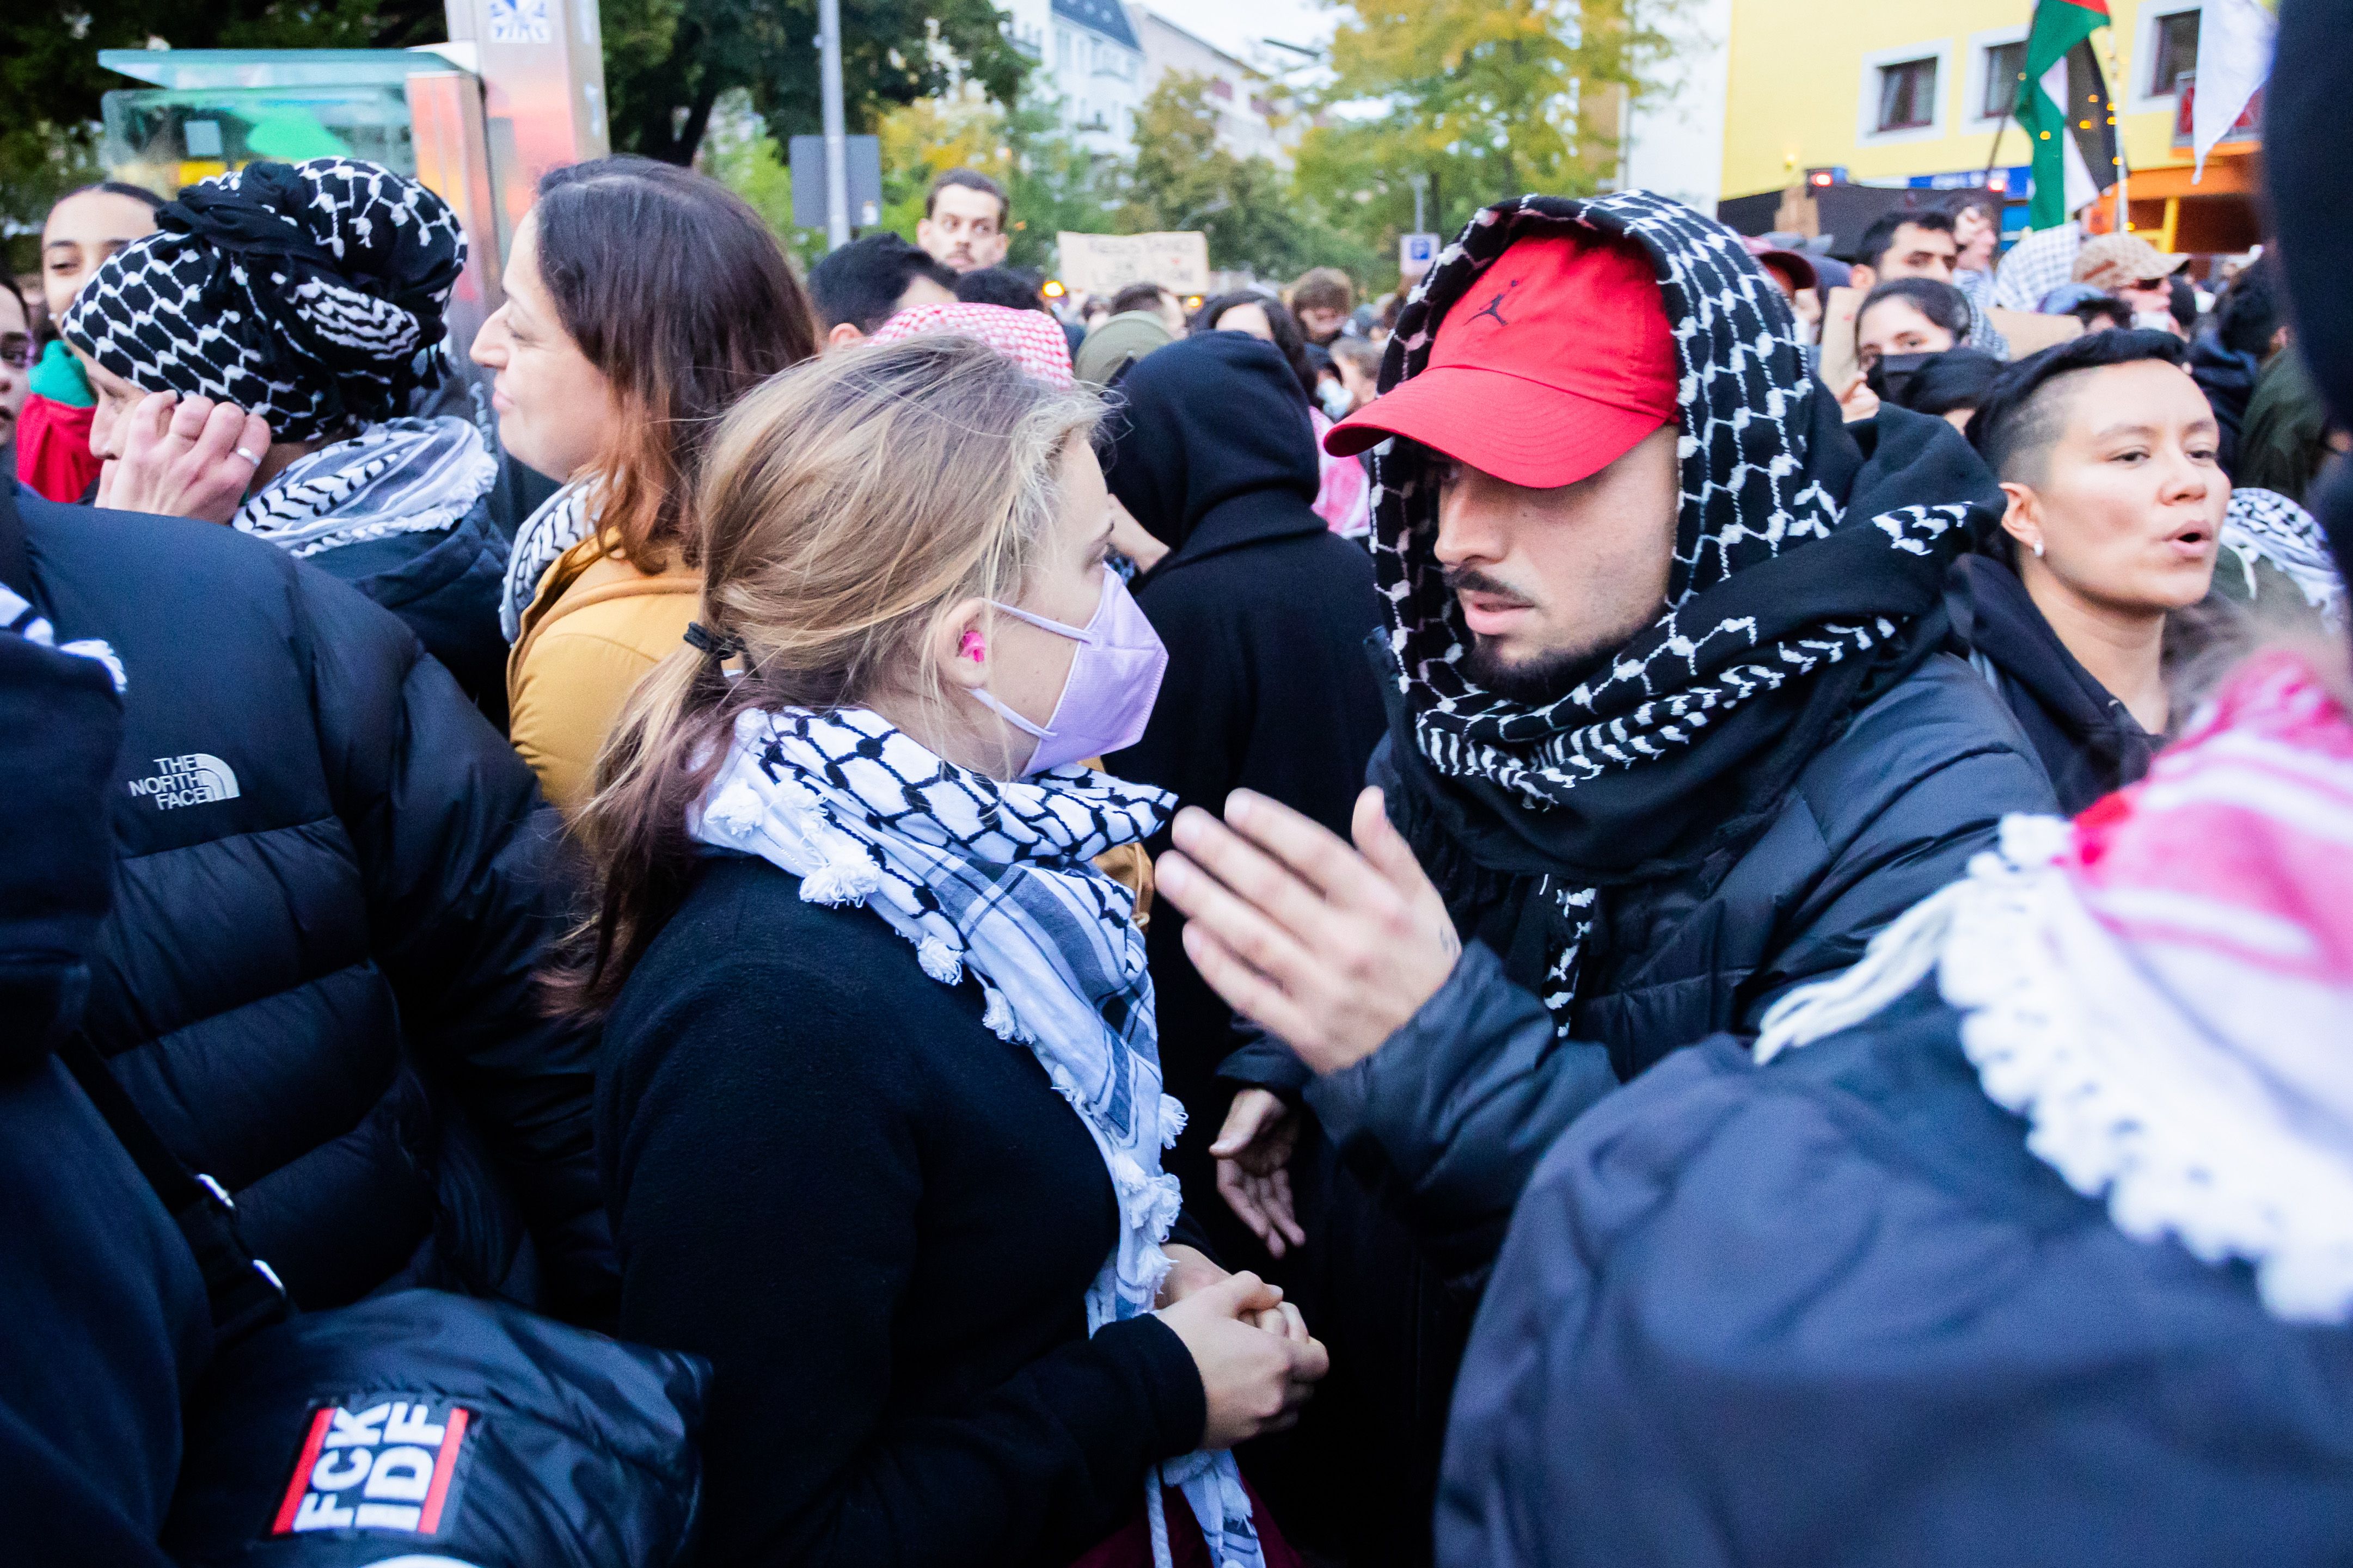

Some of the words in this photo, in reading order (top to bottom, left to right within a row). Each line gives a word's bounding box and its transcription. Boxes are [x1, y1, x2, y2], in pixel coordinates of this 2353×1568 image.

[153, 755, 197, 775] THE
[128, 771, 203, 797] NORTH
[155, 788, 207, 810] FACE
[291, 1402, 391, 1532] FCK
[355, 1401, 446, 1532] IDF
